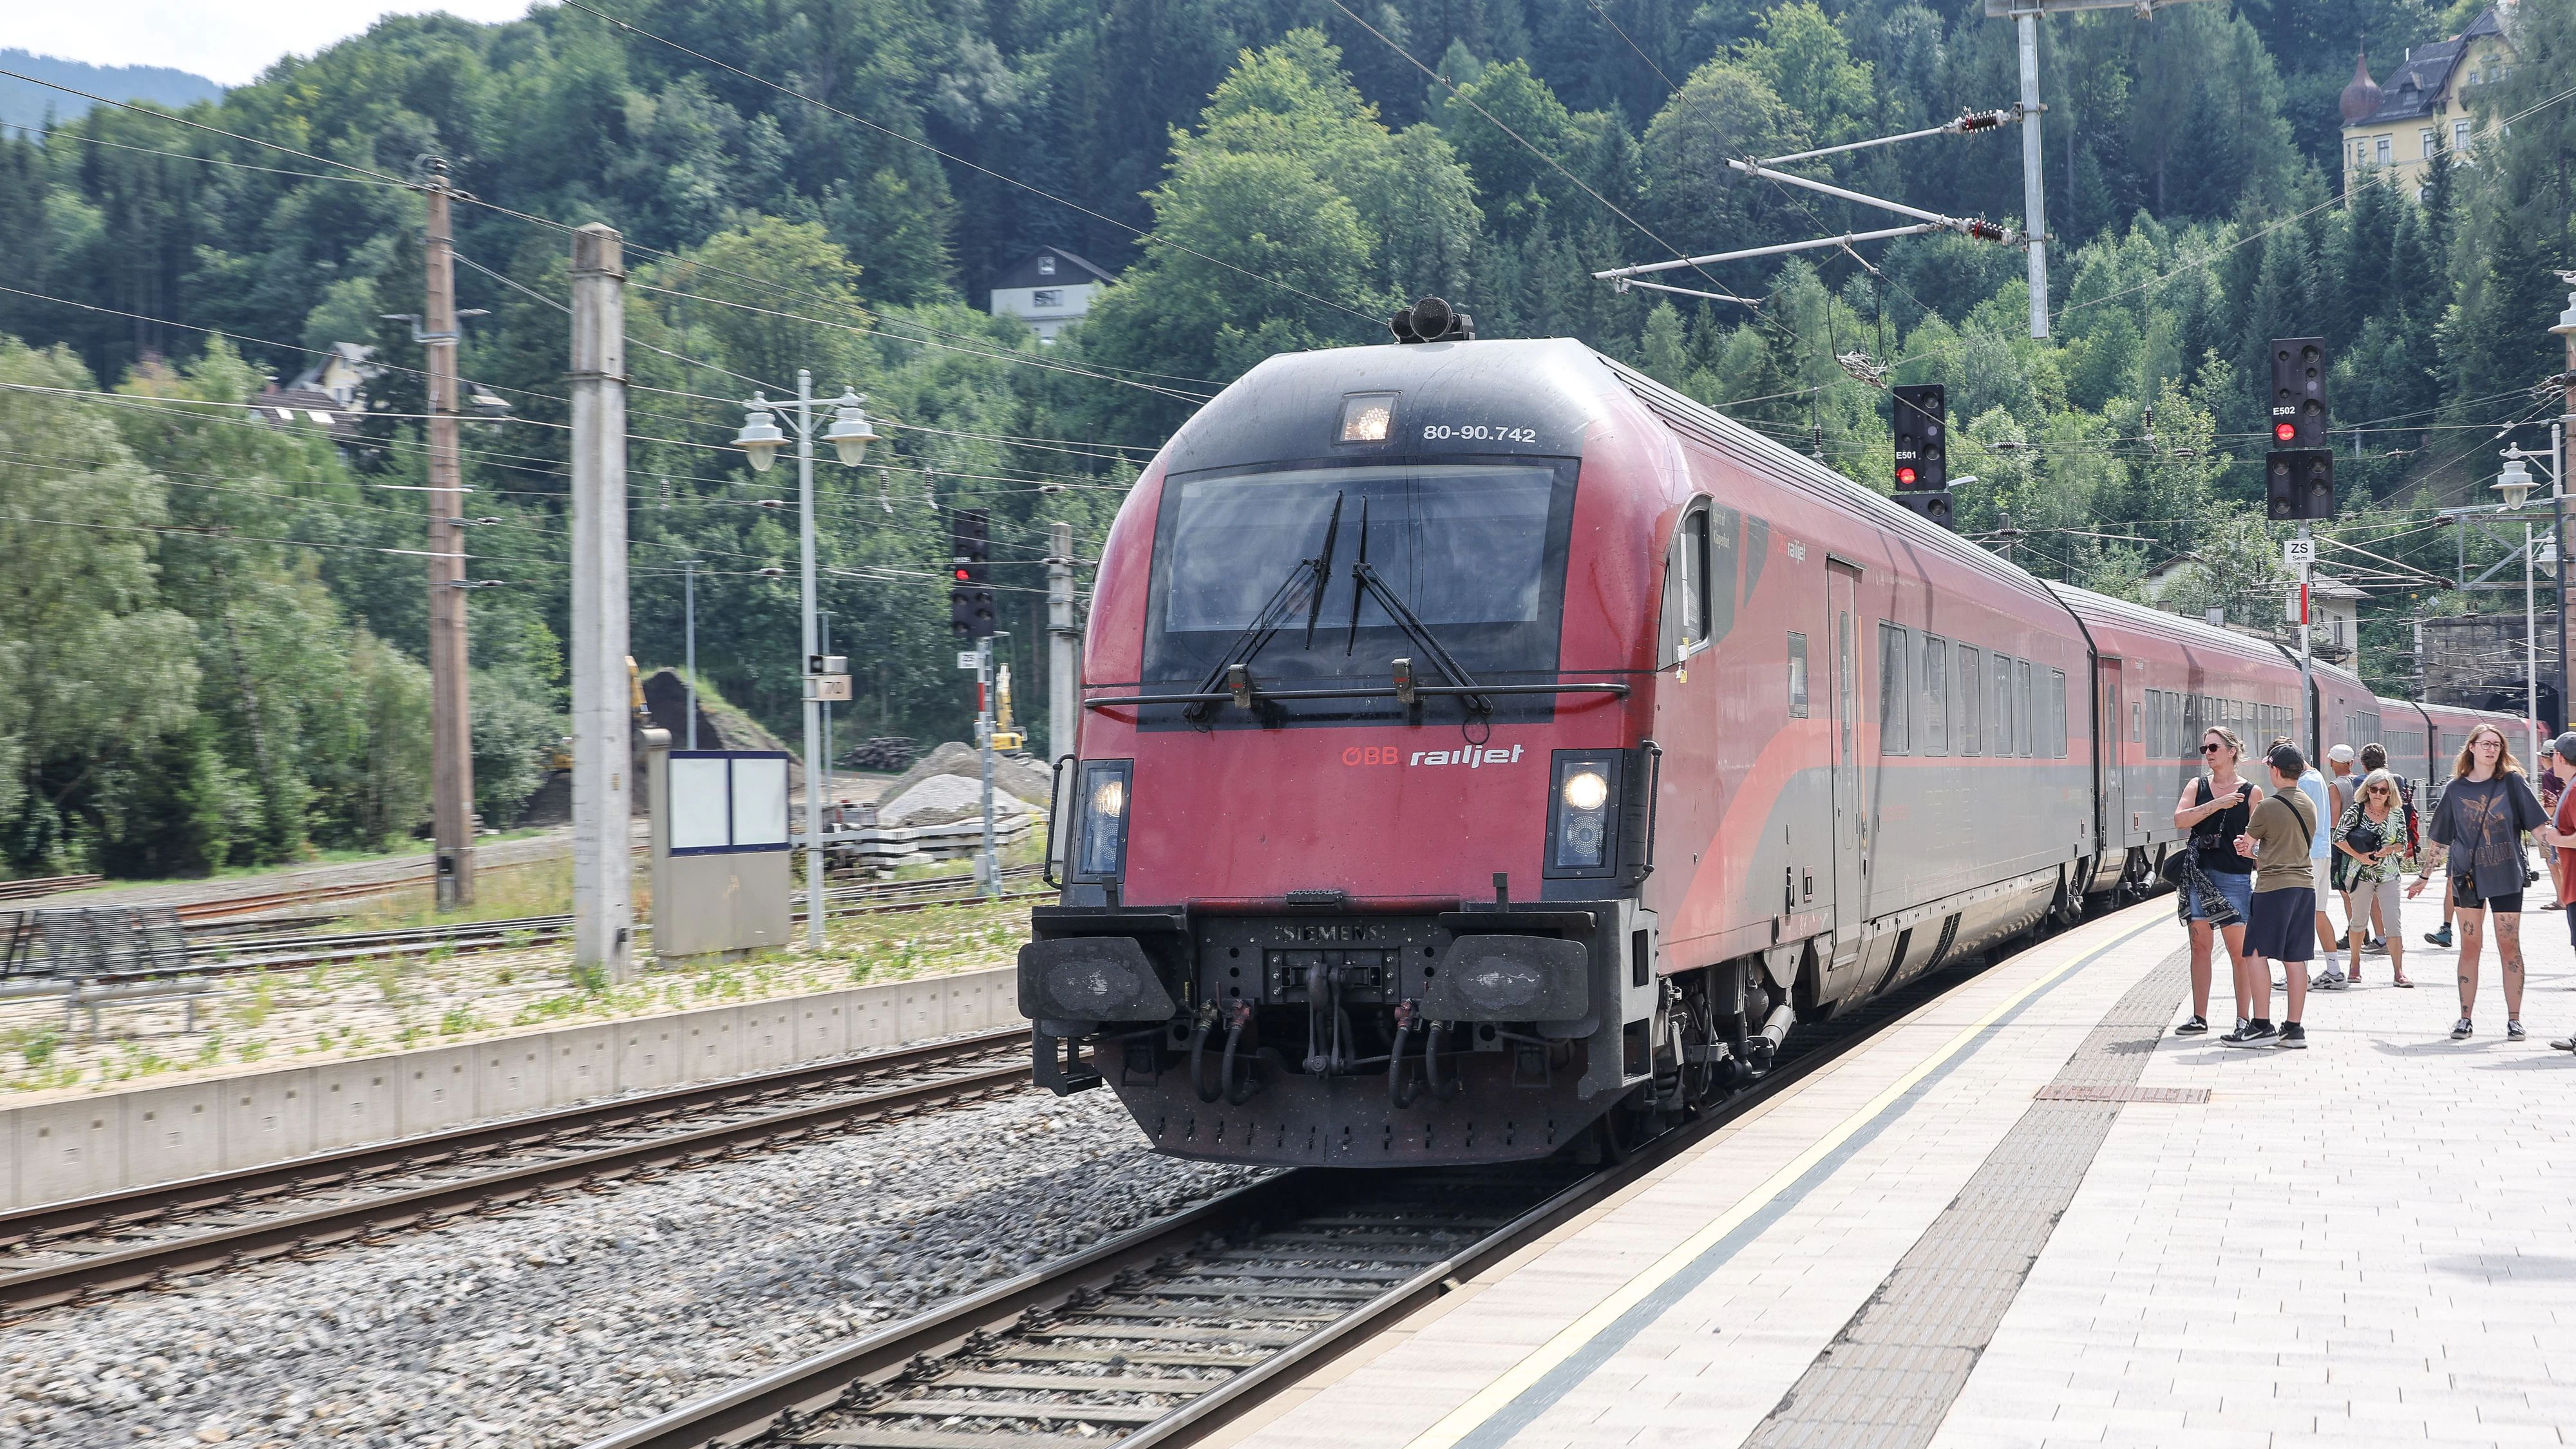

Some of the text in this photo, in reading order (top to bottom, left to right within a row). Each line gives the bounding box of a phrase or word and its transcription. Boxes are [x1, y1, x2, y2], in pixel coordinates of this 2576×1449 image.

[2273, 406, 2296, 415] E502
[1423, 425, 1537, 443] 80-90.742
[1896, 451, 1917, 460] E501
[1788, 538, 1806, 565] railjet
[2291, 543, 2308, 554] ZS
[1341, 744, 1524, 769] ÖBB railjet
[1282, 926, 1379, 942] SIEMENS
